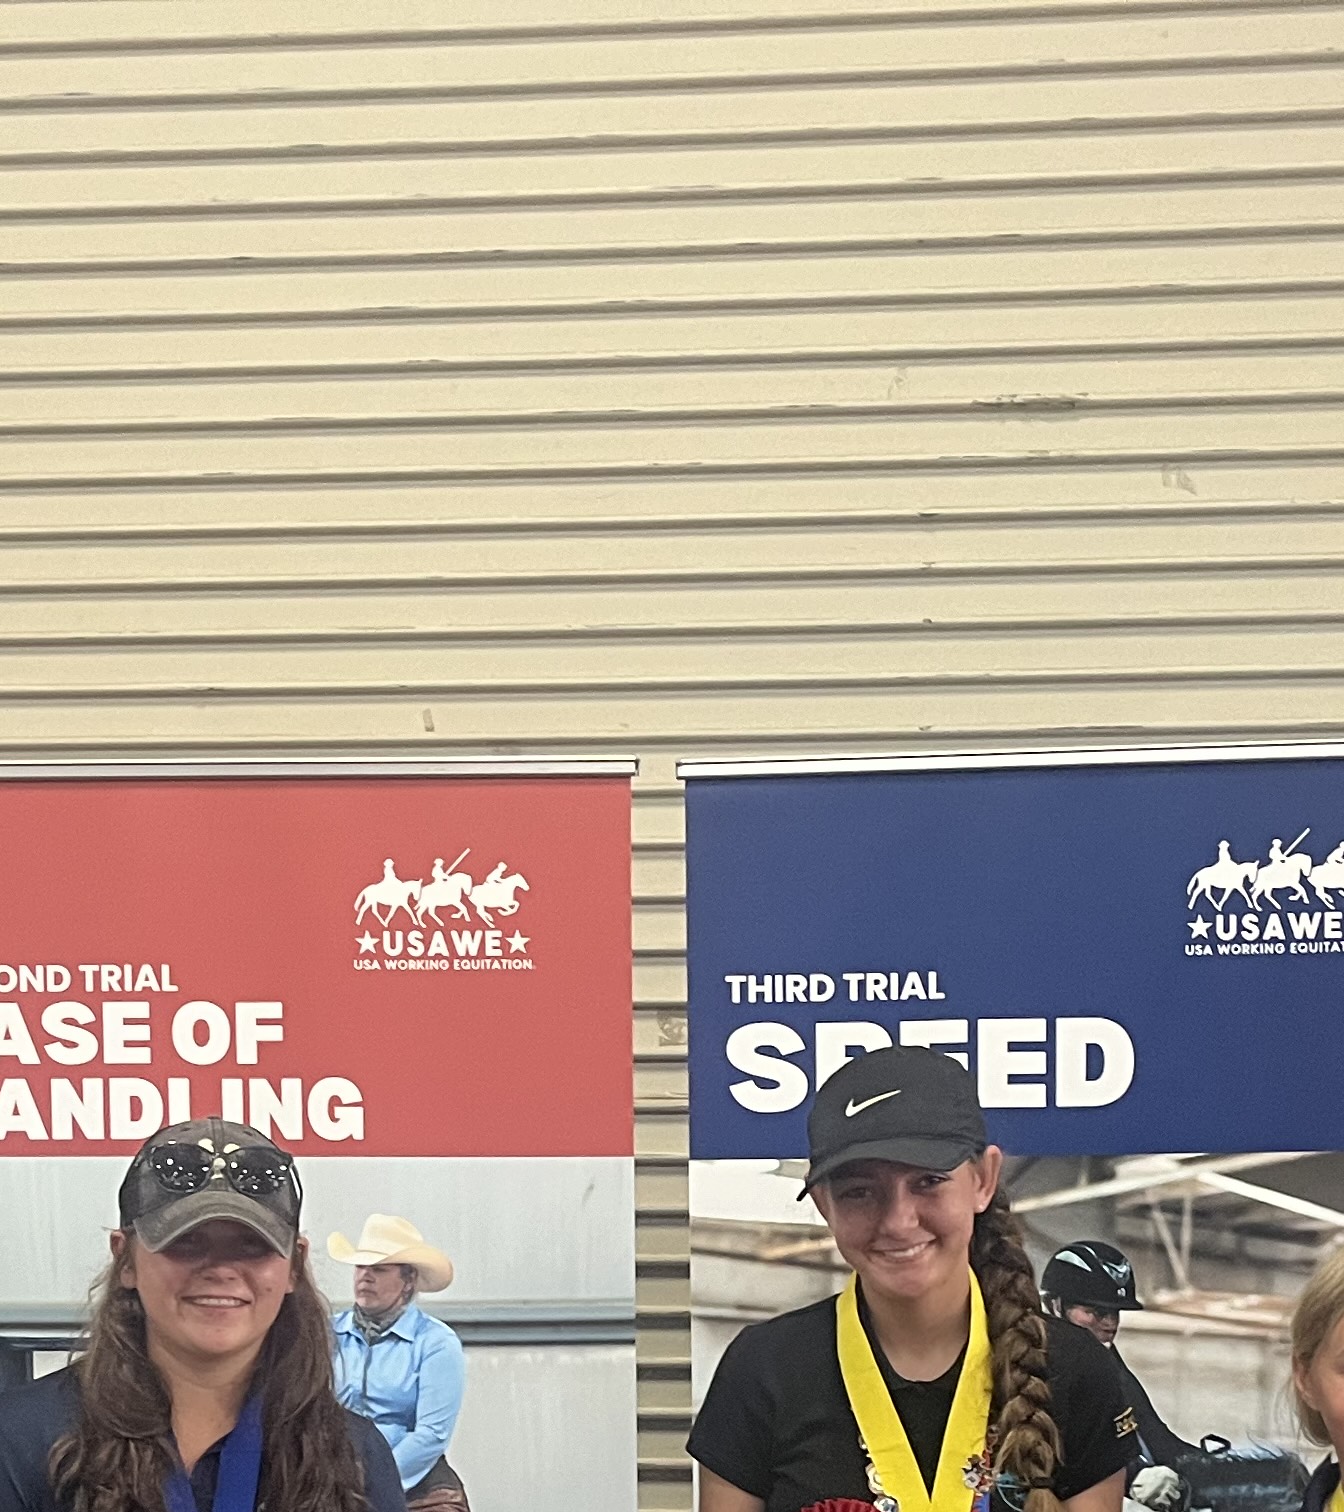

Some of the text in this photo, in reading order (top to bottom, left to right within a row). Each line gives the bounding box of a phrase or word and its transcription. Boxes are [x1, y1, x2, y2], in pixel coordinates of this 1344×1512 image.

[1216, 911, 1343, 942] USAWE
[382, 929, 503, 957] USAWE
[1184, 944, 1214, 957] USA
[1217, 942, 1286, 956] WORKING
[78, 964, 178, 992] TRIAL
[353, 959, 532, 970] USA WORKING EQUITATION
[725, 971, 946, 1004] THIRD TRIAL
[171, 1000, 284, 1066] OF
